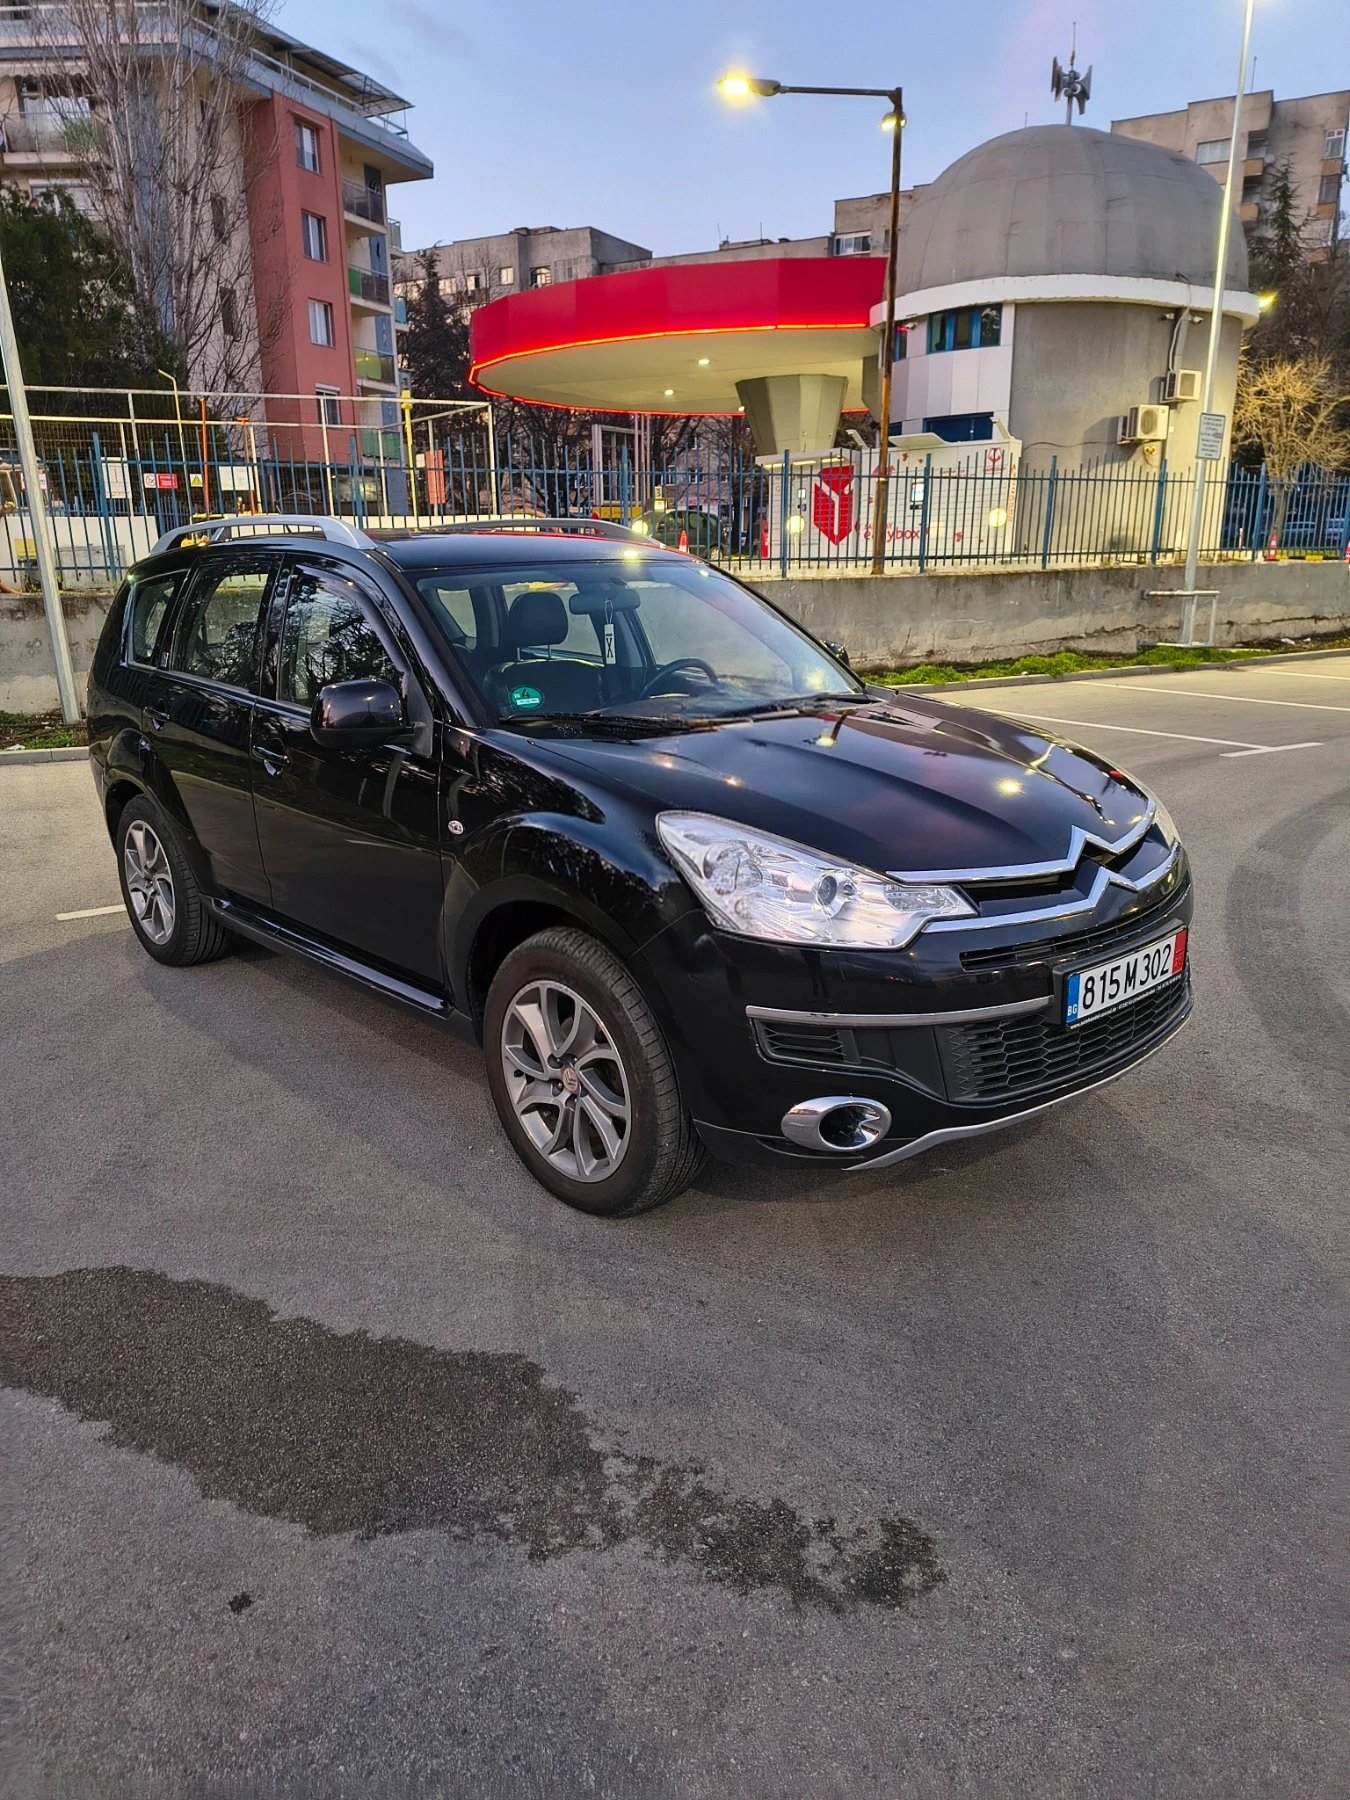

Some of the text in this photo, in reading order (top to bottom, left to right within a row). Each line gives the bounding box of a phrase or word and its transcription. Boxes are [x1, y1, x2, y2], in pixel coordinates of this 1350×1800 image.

[863, 526, 920, 543] eybox
[522, 688, 530, 698] 4
[1066, 1003, 1078, 1016] BG
